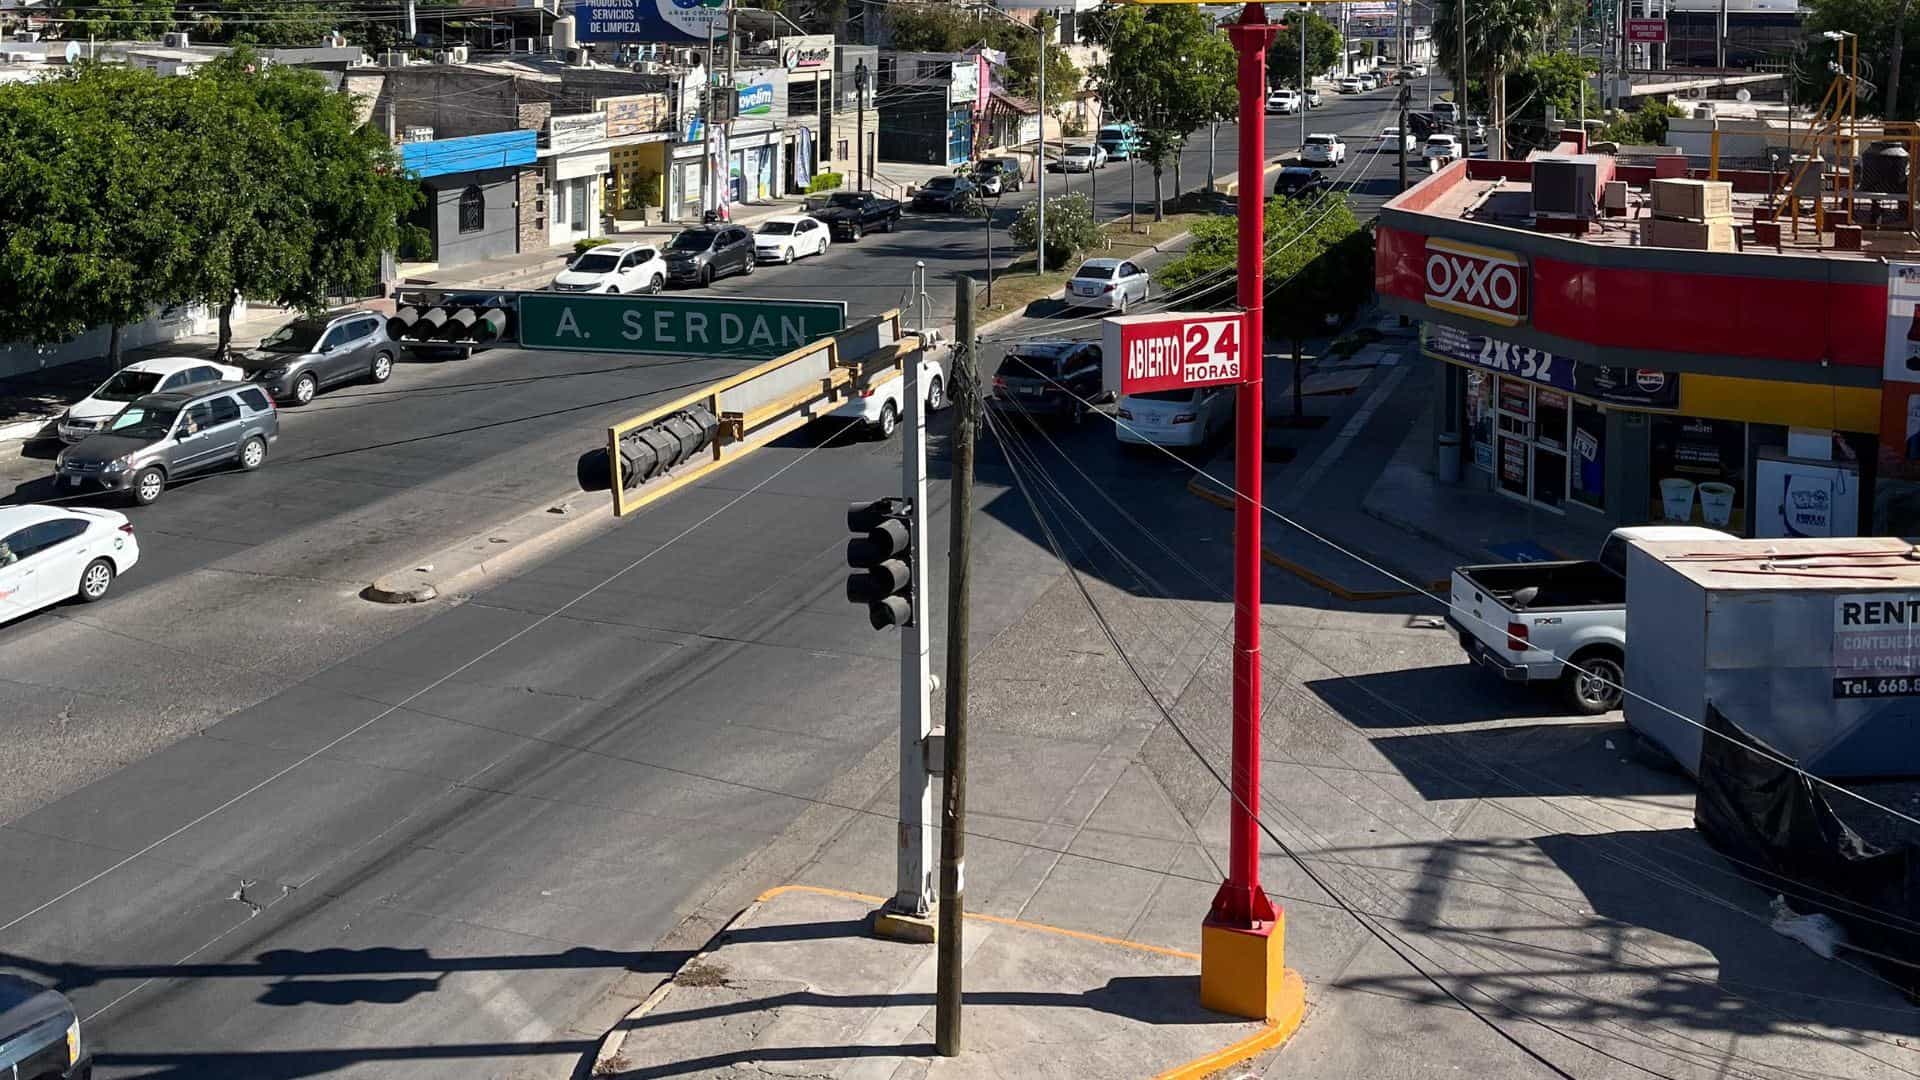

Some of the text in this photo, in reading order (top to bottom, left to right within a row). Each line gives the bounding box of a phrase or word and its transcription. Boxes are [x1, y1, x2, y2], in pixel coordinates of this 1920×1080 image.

[592, 9, 634, 19] SERVICIOS
[591, 22, 640, 33] DE LIMPIEZA
[739, 88, 771, 108] ovelim
[1427, 254, 1517, 309] OXXO
[555, 307, 806, 346] A. SERDAN
[1127, 323, 1239, 380] ABIERTO 24
[1185, 363, 1239, 381] HORAS
[1842, 680, 1872, 694] Tel.
